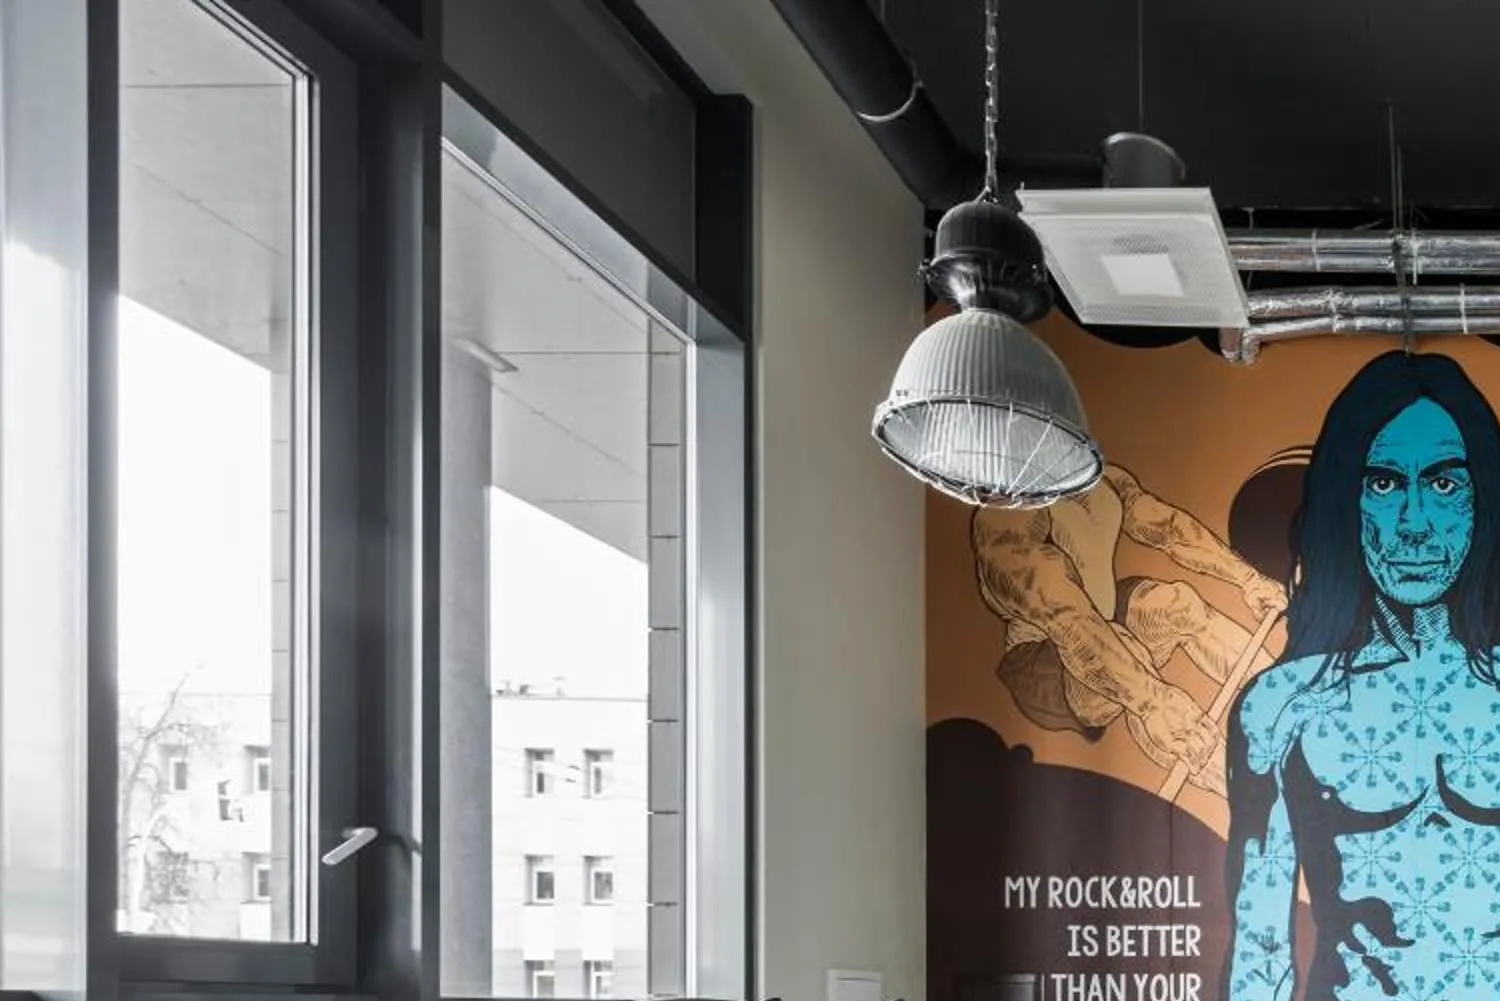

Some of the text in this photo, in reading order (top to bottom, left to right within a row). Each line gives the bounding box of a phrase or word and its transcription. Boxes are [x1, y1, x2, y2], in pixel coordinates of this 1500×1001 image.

[1004, 875, 1201, 908] MY ROCK&ROLL
[1067, 925, 1200, 957] IS BETTER
